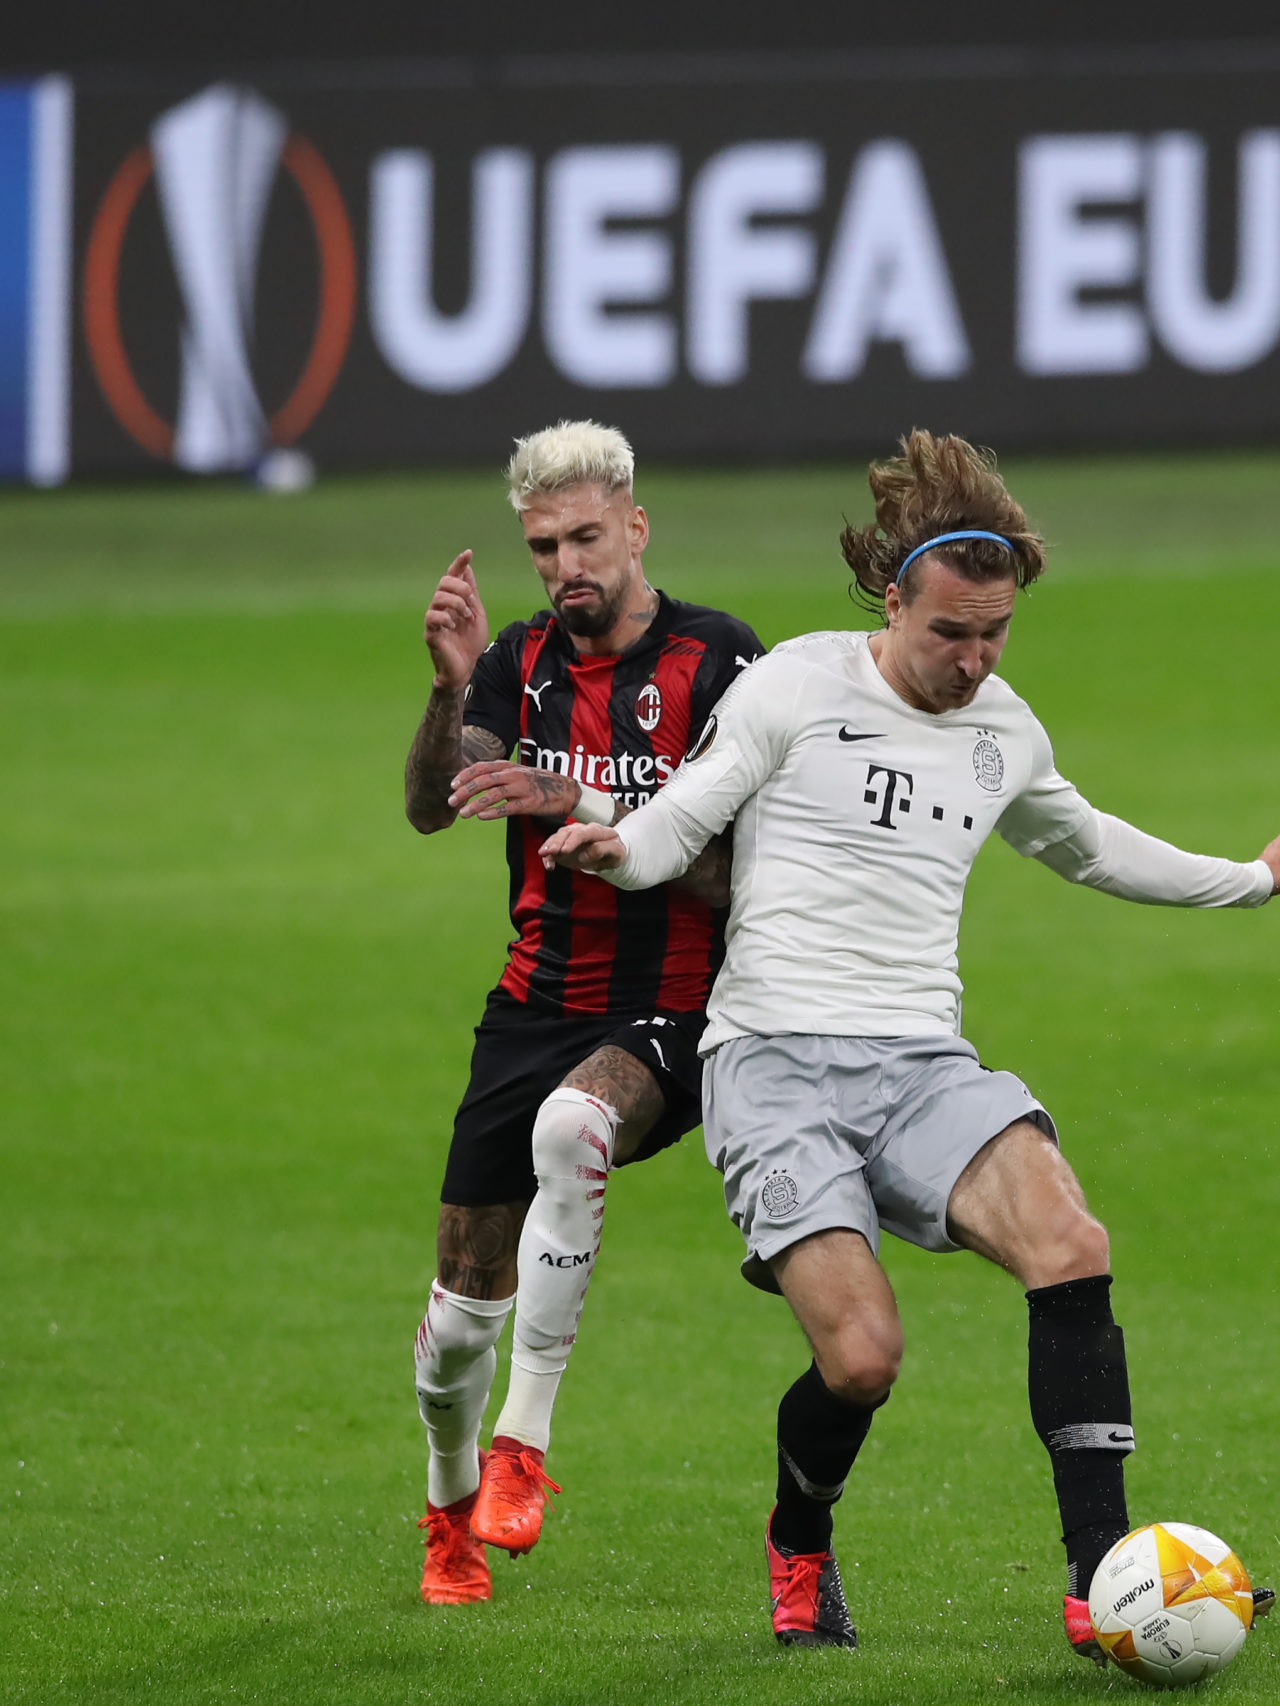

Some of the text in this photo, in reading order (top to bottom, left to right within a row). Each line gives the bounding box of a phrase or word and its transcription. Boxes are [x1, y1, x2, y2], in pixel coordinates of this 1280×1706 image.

[369, 138, 971, 393] UEFA
[519, 737, 675, 787] Emirates
[539, 1251, 591, 1269] ACM
[1113, 1578, 1155, 1613] molten
[1141, 1618, 1171, 1641] EUROPA
